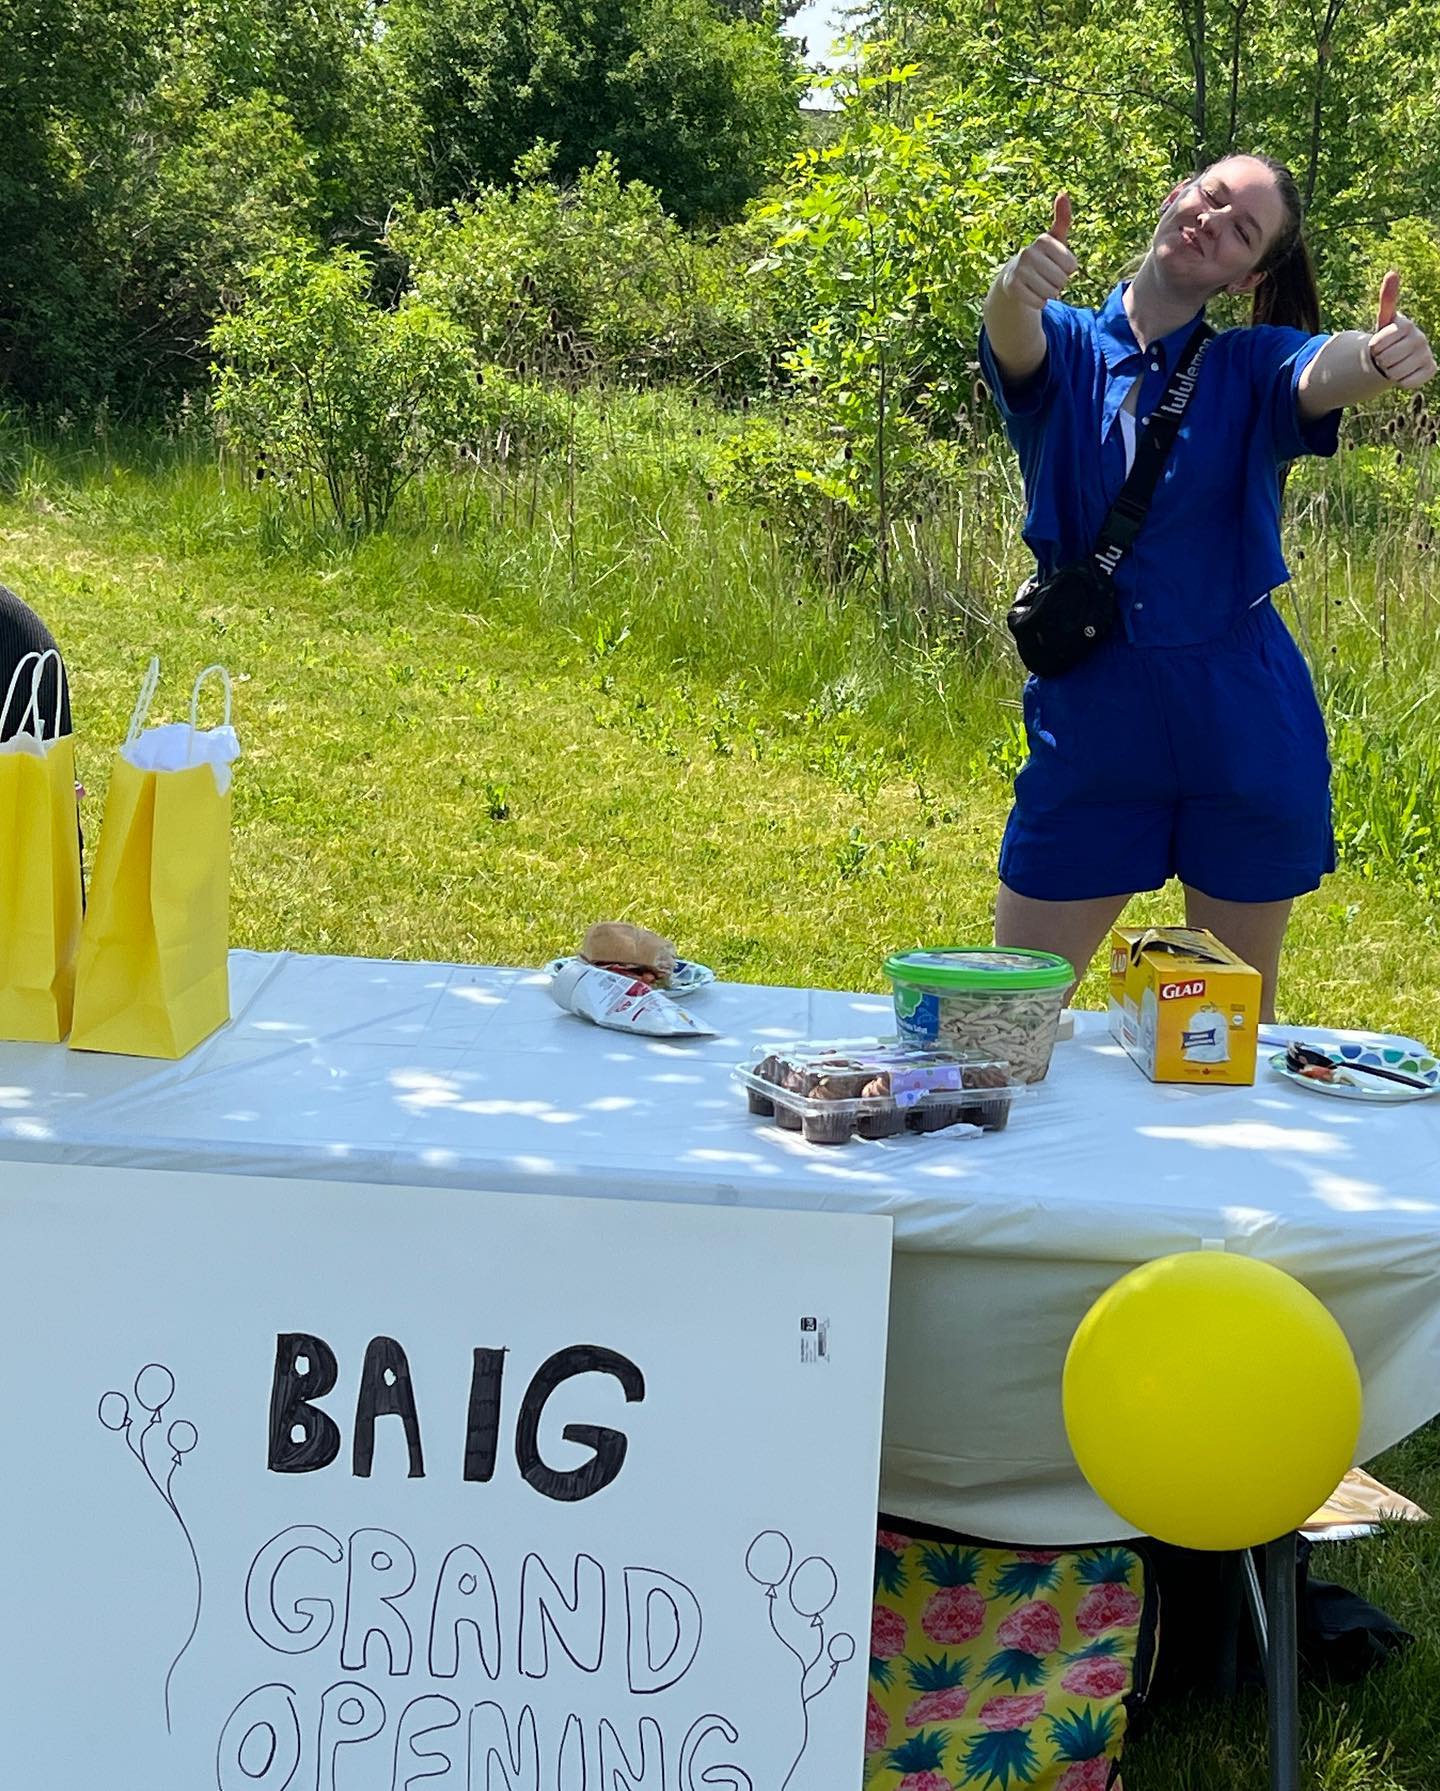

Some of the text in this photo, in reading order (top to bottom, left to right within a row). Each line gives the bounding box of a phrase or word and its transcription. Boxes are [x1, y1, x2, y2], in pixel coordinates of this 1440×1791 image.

[1162, 982, 1204, 1000] GLAD
[267, 1332, 646, 1502] BAIG
[245, 1524, 703, 1694] GRAND
[217, 1681, 753, 1791] OPENING
